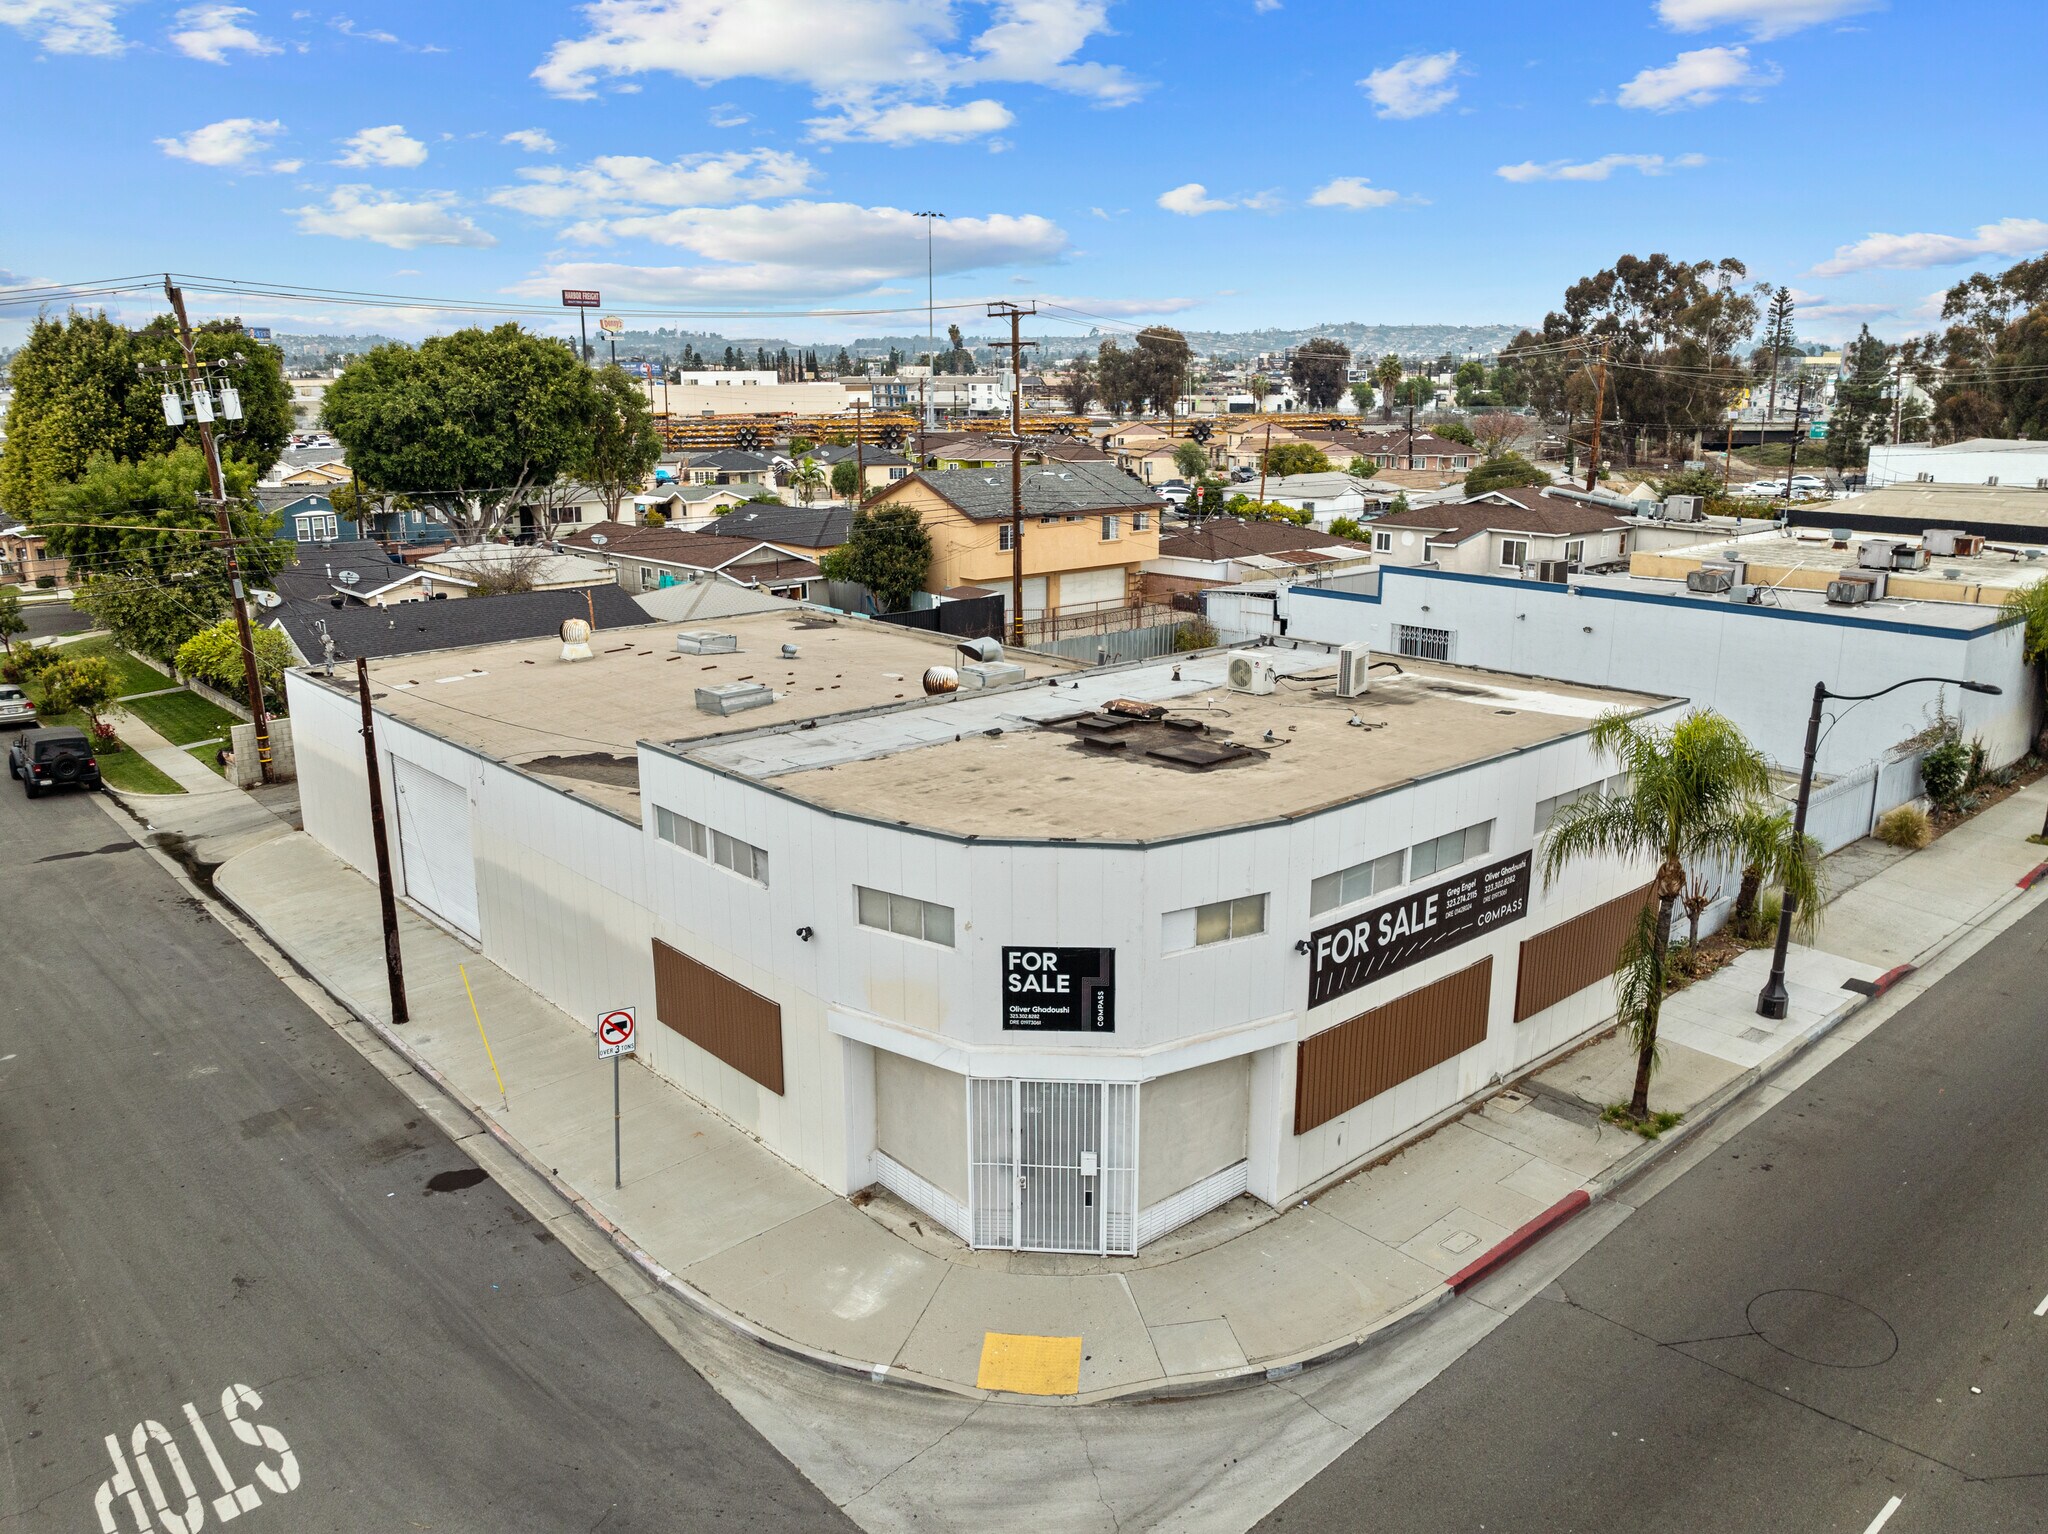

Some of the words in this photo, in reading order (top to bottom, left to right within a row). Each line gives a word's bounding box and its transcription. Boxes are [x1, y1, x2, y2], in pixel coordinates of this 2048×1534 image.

[1484, 870, 1501, 883] Oliver
[1500, 859, 1527, 877] Ghadoushi
[1446, 886, 1461, 898] Greg
[1461, 878, 1477, 893] Engel
[1482, 894, 1492, 904] DRE
[1445, 909, 1454, 919] DRE
[1477, 898, 1523, 927] COMPASS
[1316, 921, 1371, 973] FOR
[1378, 893, 1440, 947] SALE
[1008, 952, 1058, 971] FOR
[1008, 973, 1070, 993] SALE
[1009, 1005, 1031, 1013] Oliver
[1031, 1006, 1070, 1014] Ghadoushi
[600, 1048, 613, 1056] OVER
[615, 1045, 620, 1054] 3
[621, 1043, 635, 1051] TONS
[94, 1383, 301, 1534] STOP
